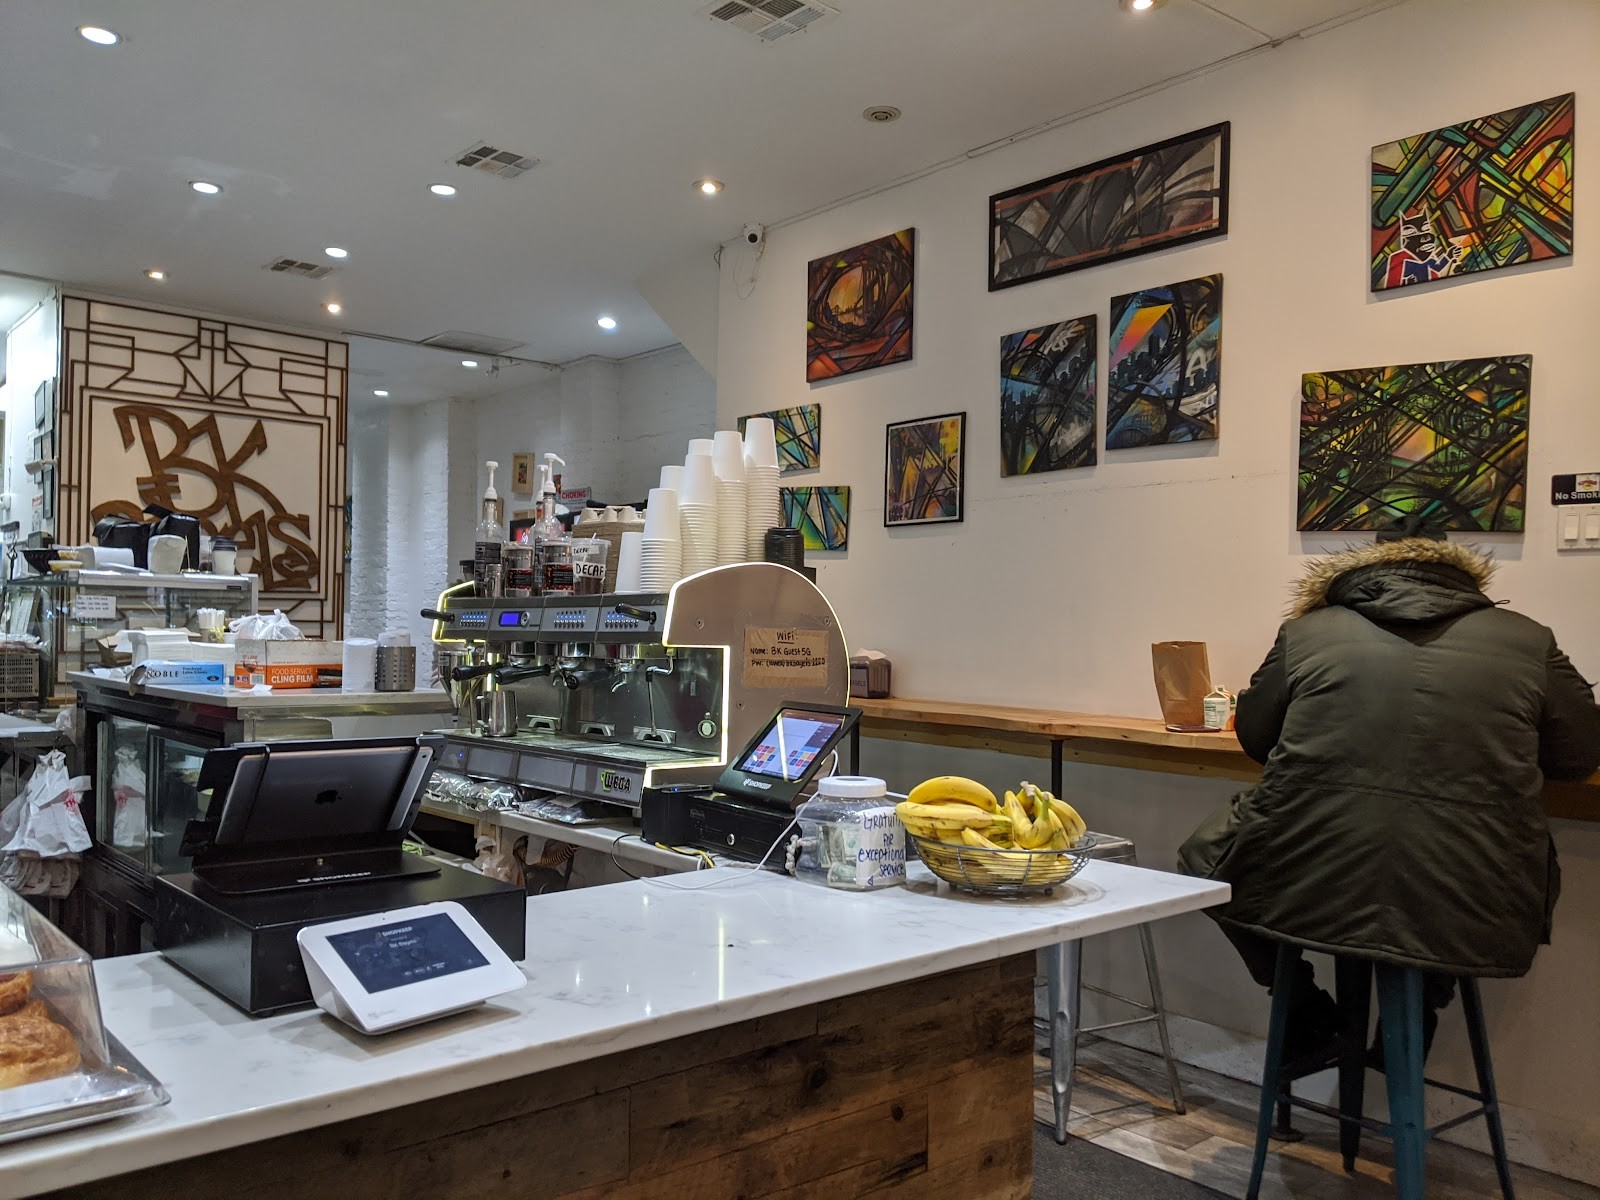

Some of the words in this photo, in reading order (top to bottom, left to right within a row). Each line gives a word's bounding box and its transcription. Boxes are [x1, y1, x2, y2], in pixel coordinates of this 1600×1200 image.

[561, 489, 587, 500] CHOKING
[1555, 492, 1569, 500] No
[575, 563, 604, 577] DECAF
[770, 646, 782, 656] BK
[145, 669, 180, 680] NOBLE
[271, 676, 295, 684] CLING
[296, 675, 314, 683] FILM
[604, 771, 631, 791] WEGA
